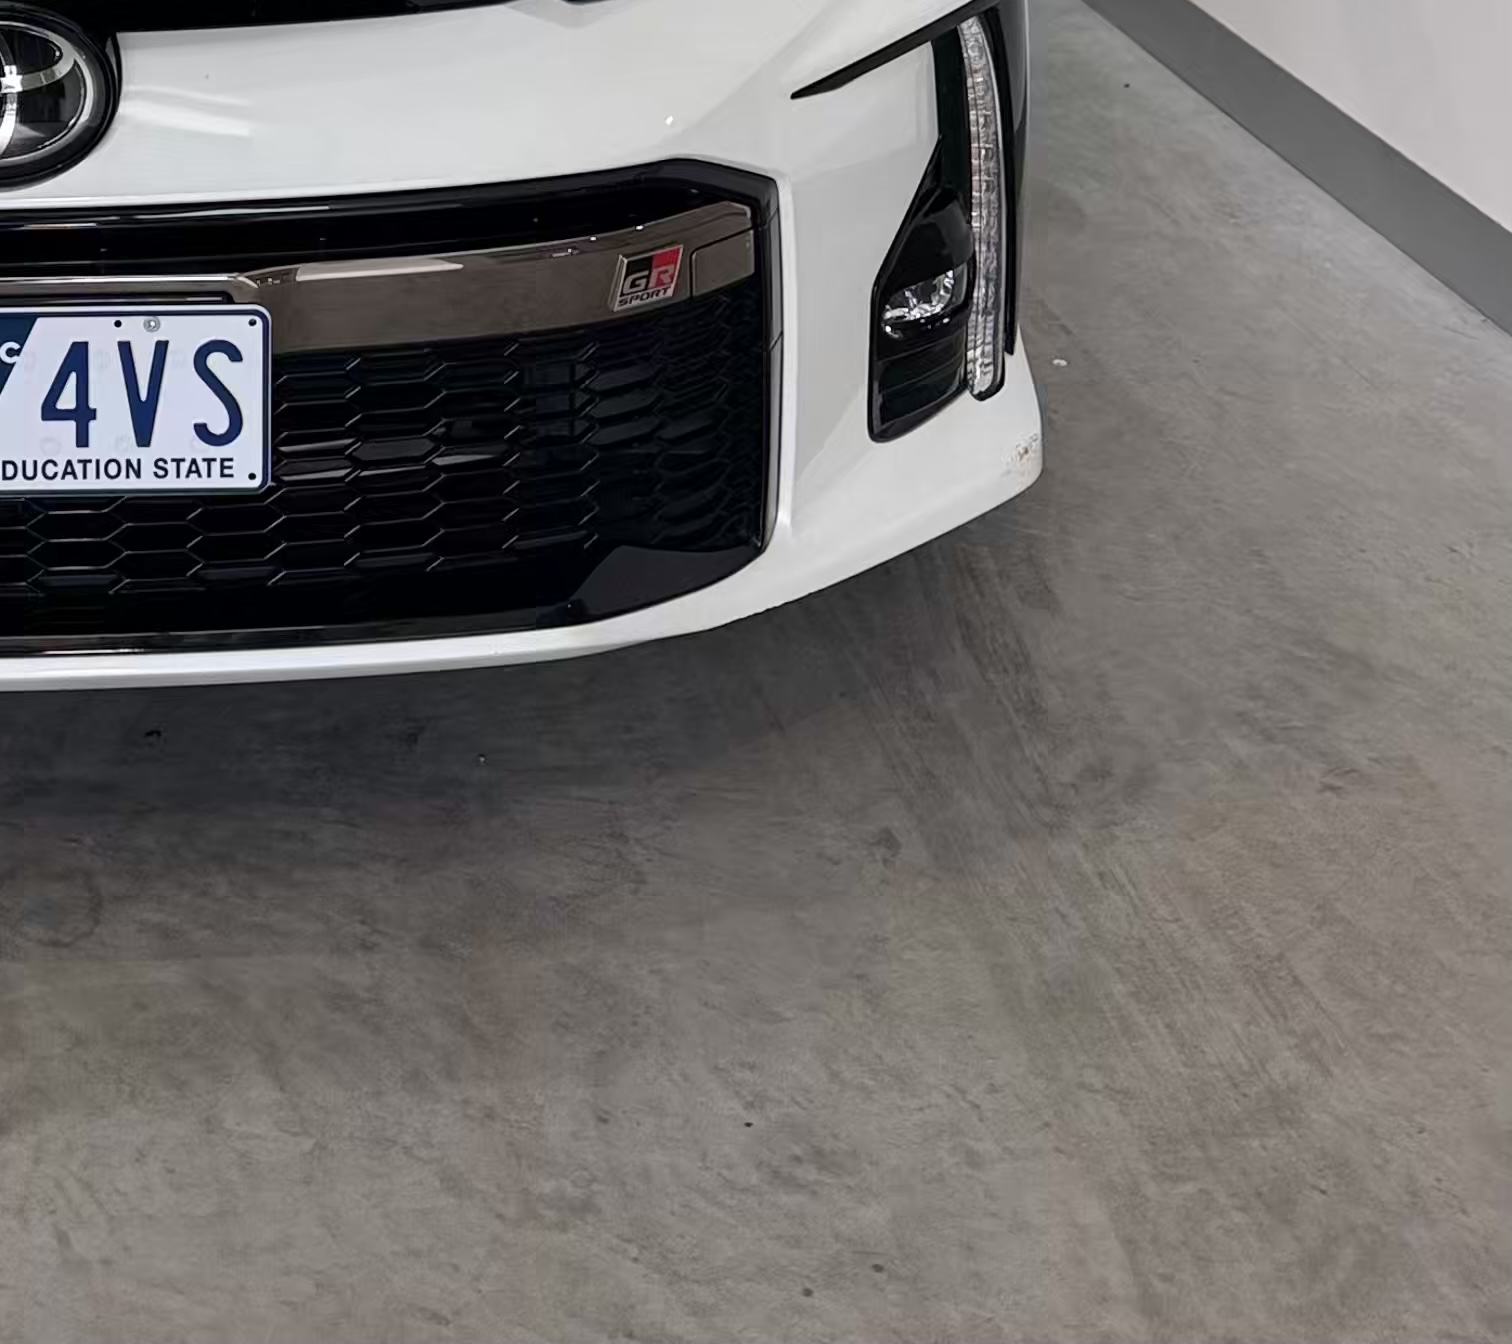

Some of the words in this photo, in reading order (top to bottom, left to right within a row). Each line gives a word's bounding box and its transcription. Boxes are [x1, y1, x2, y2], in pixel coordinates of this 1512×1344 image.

[622, 264, 675, 294] GR
[618, 287, 672, 306] SPORT
[40, 339, 245, 448] 4VS
[152, 457, 235, 480] STATE
